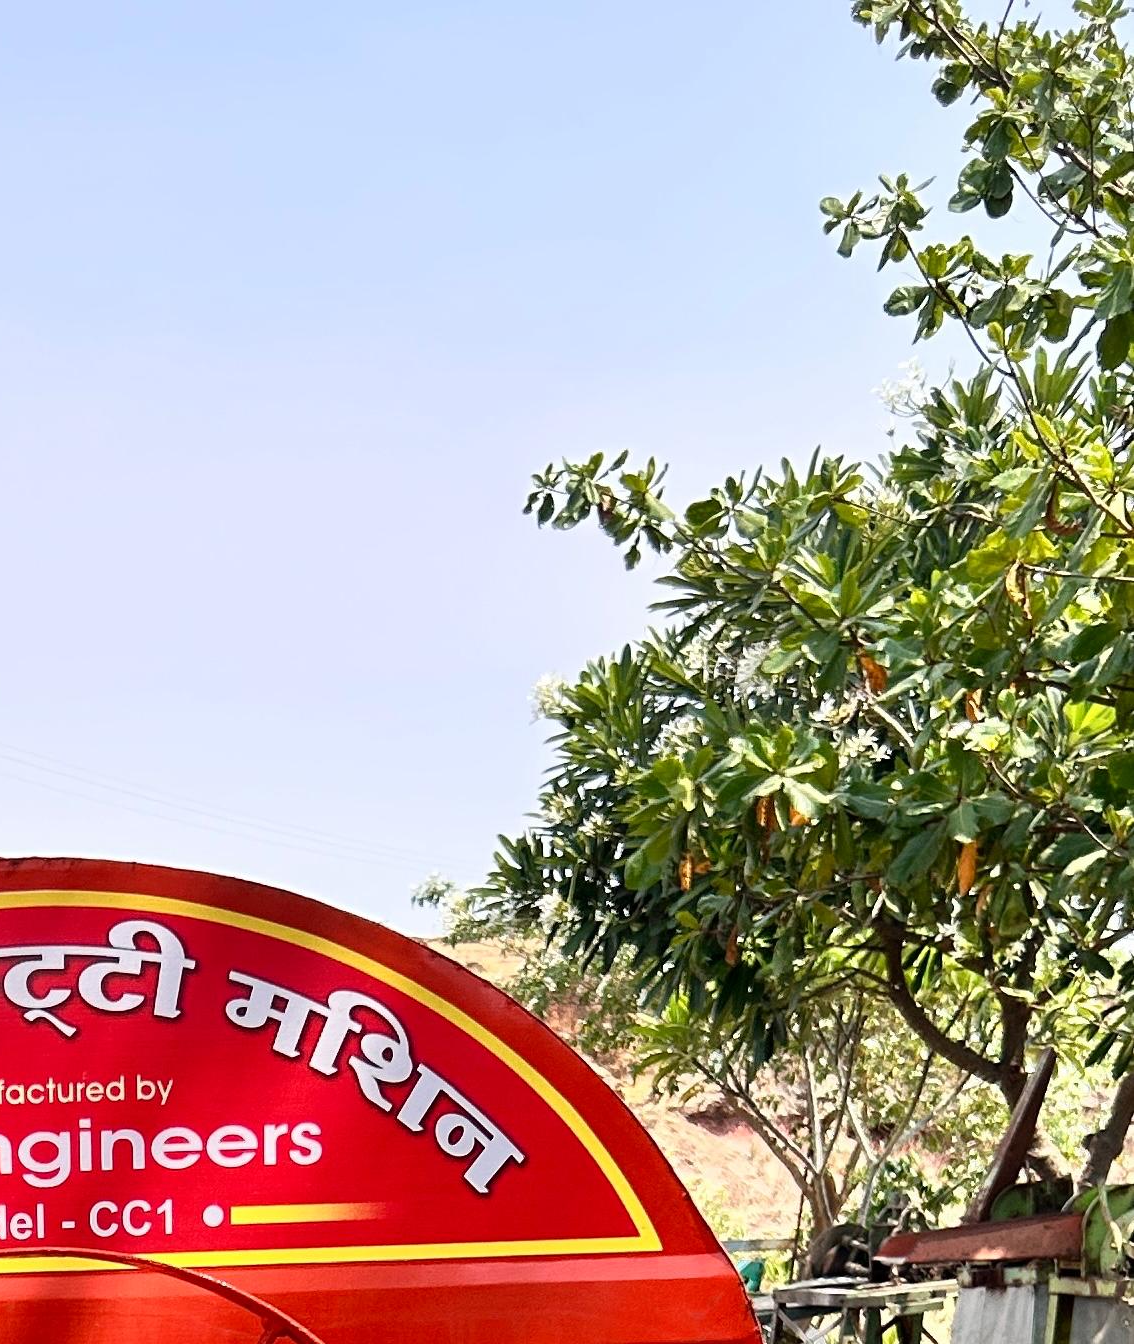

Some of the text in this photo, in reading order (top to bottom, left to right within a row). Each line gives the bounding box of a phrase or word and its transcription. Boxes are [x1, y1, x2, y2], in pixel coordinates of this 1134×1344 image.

[136, 1074, 174, 1106] by
[225, 970, 525, 1194] मशिन
[89, 1198, 173, 1238] CC1
